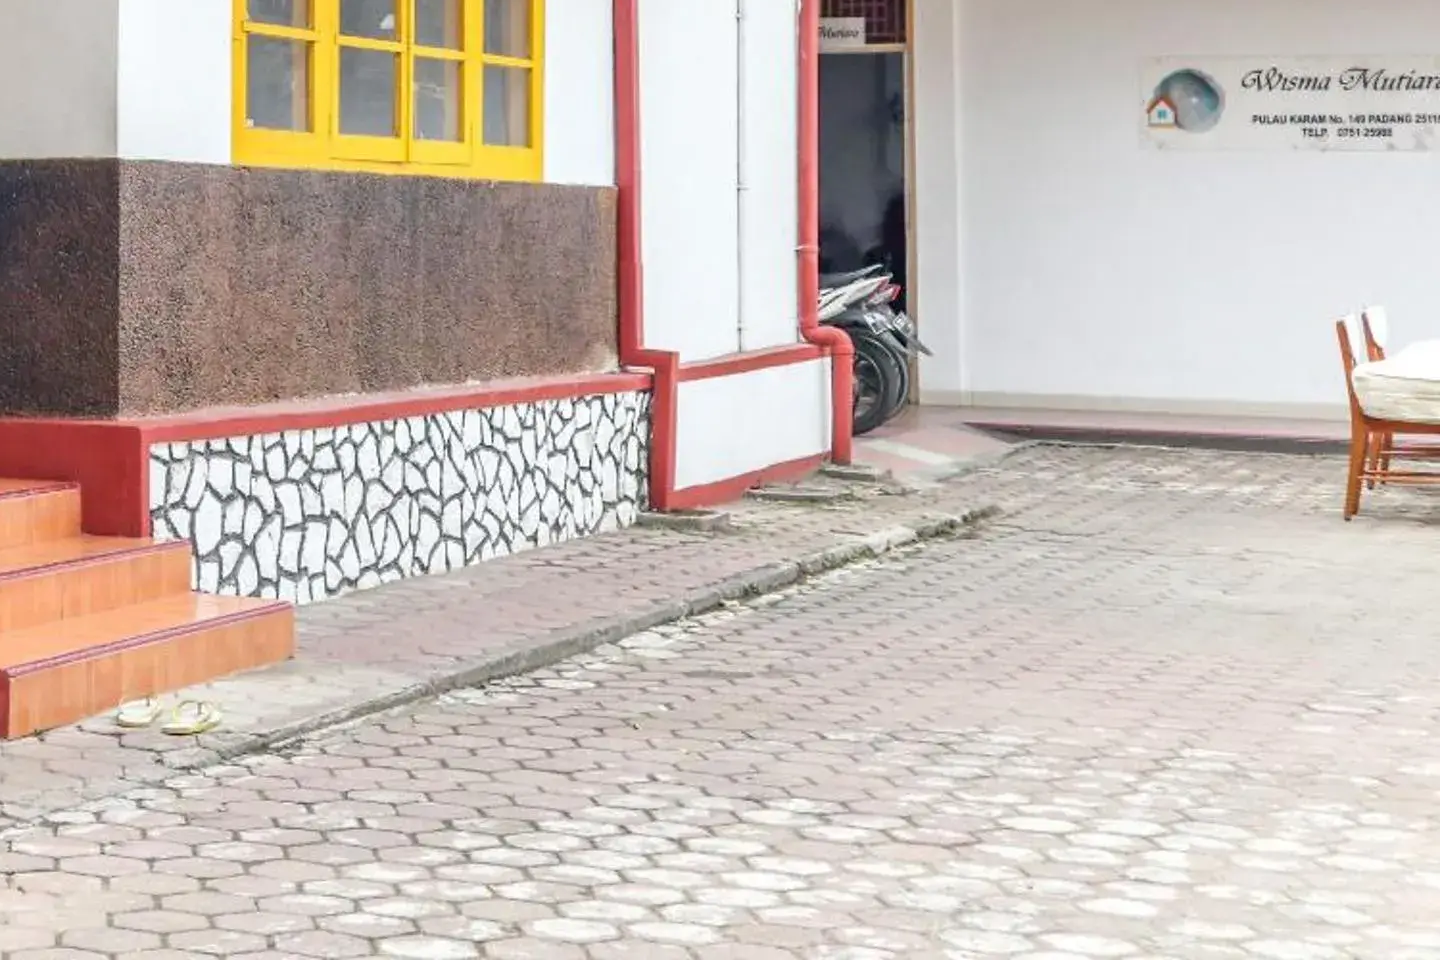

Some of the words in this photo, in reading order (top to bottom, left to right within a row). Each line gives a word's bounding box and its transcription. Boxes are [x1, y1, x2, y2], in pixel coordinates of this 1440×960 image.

[1241, 66, 1331, 91] Wisma
[1252, 114, 1287, 124] PULAU
[1290, 114, 1326, 124] KARAM
[1369, 113, 1412, 124] PADANG
